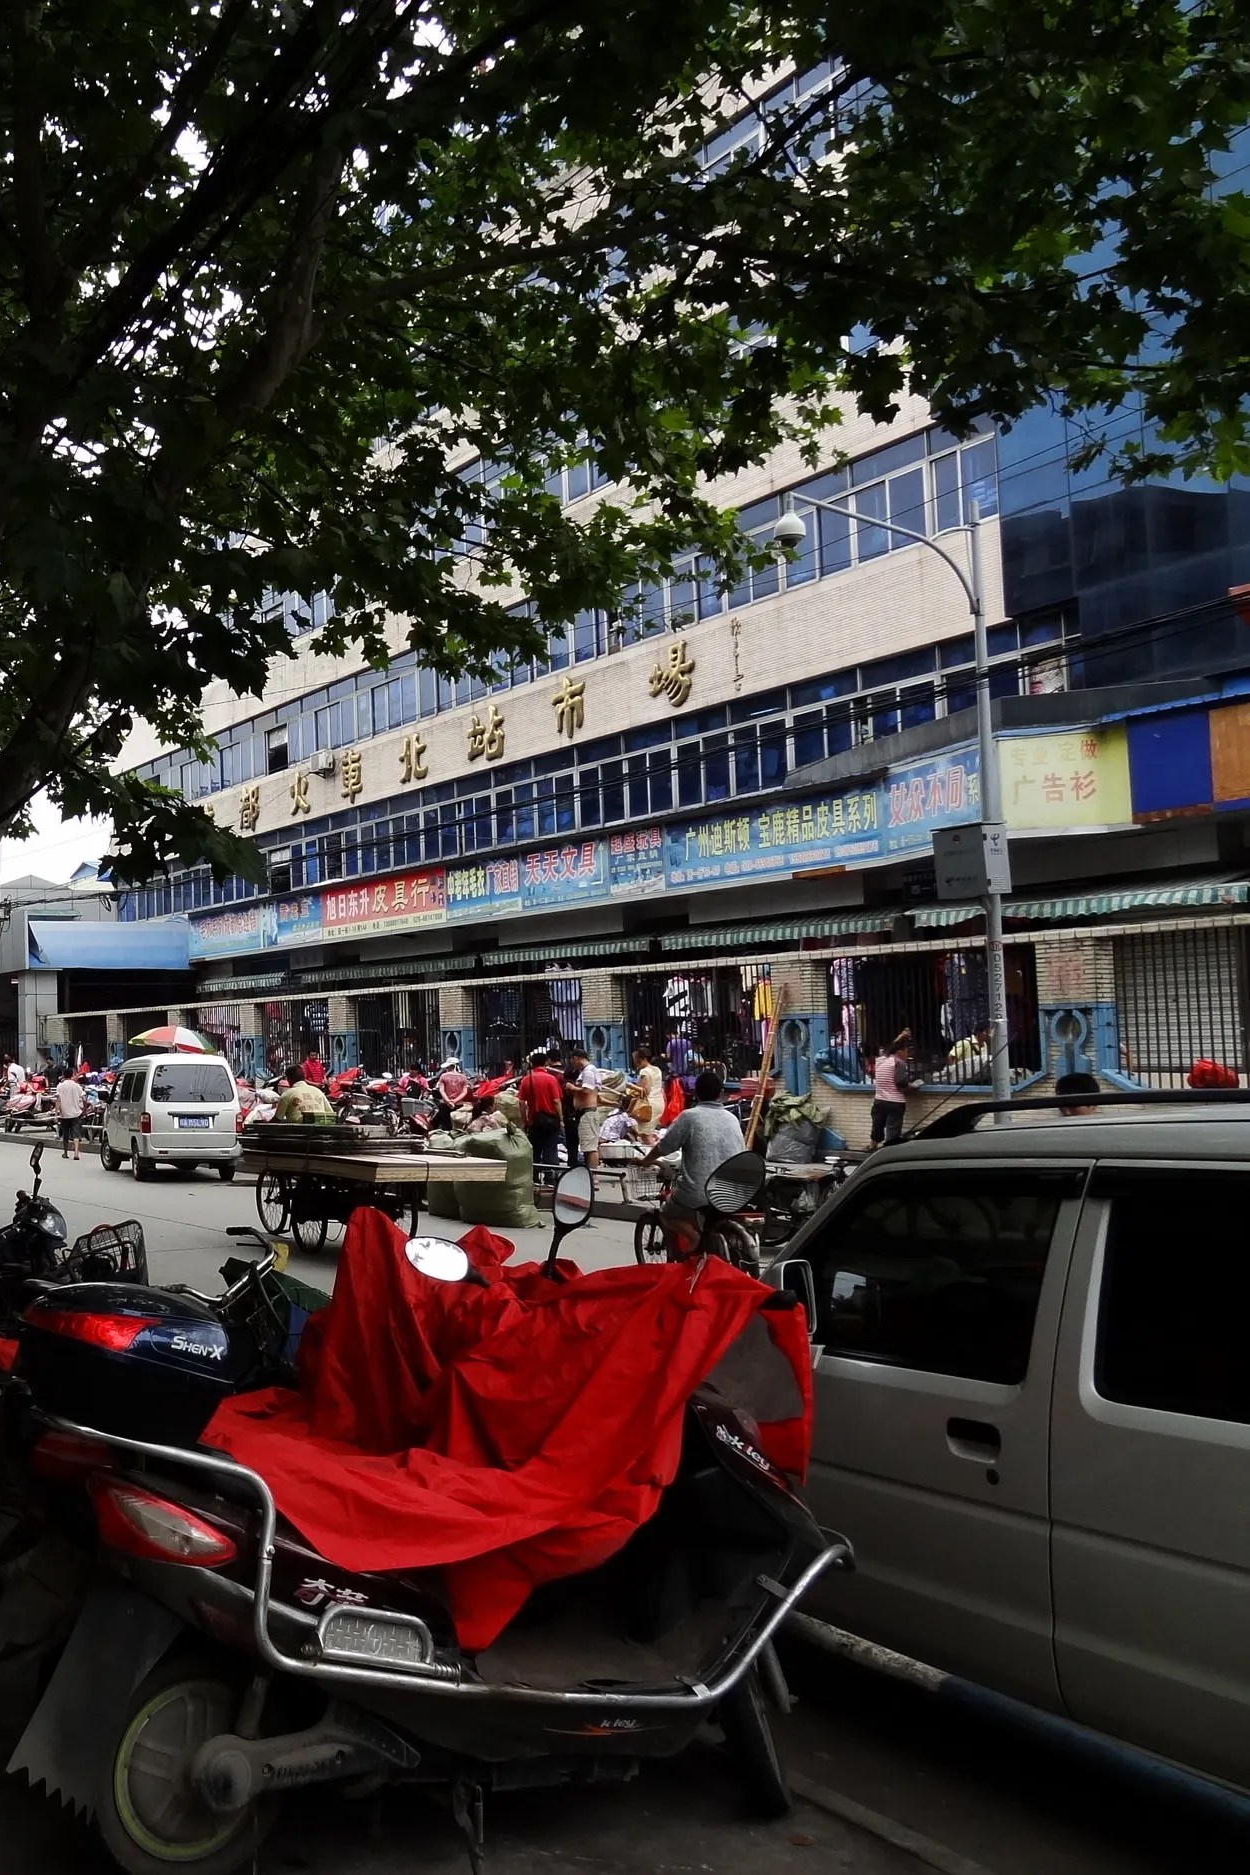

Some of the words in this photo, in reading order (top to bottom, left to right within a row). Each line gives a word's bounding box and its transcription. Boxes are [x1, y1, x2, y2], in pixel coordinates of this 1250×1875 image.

[204, 639, 696, 832] 都火車北站市場
[1012, 770, 1097, 806] 广告衫
[685, 817, 750, 860] 广州迪斯顿
[758, 792, 878, 849] 宝鹿精品皮具系列
[524, 841, 597, 887] 天天文具
